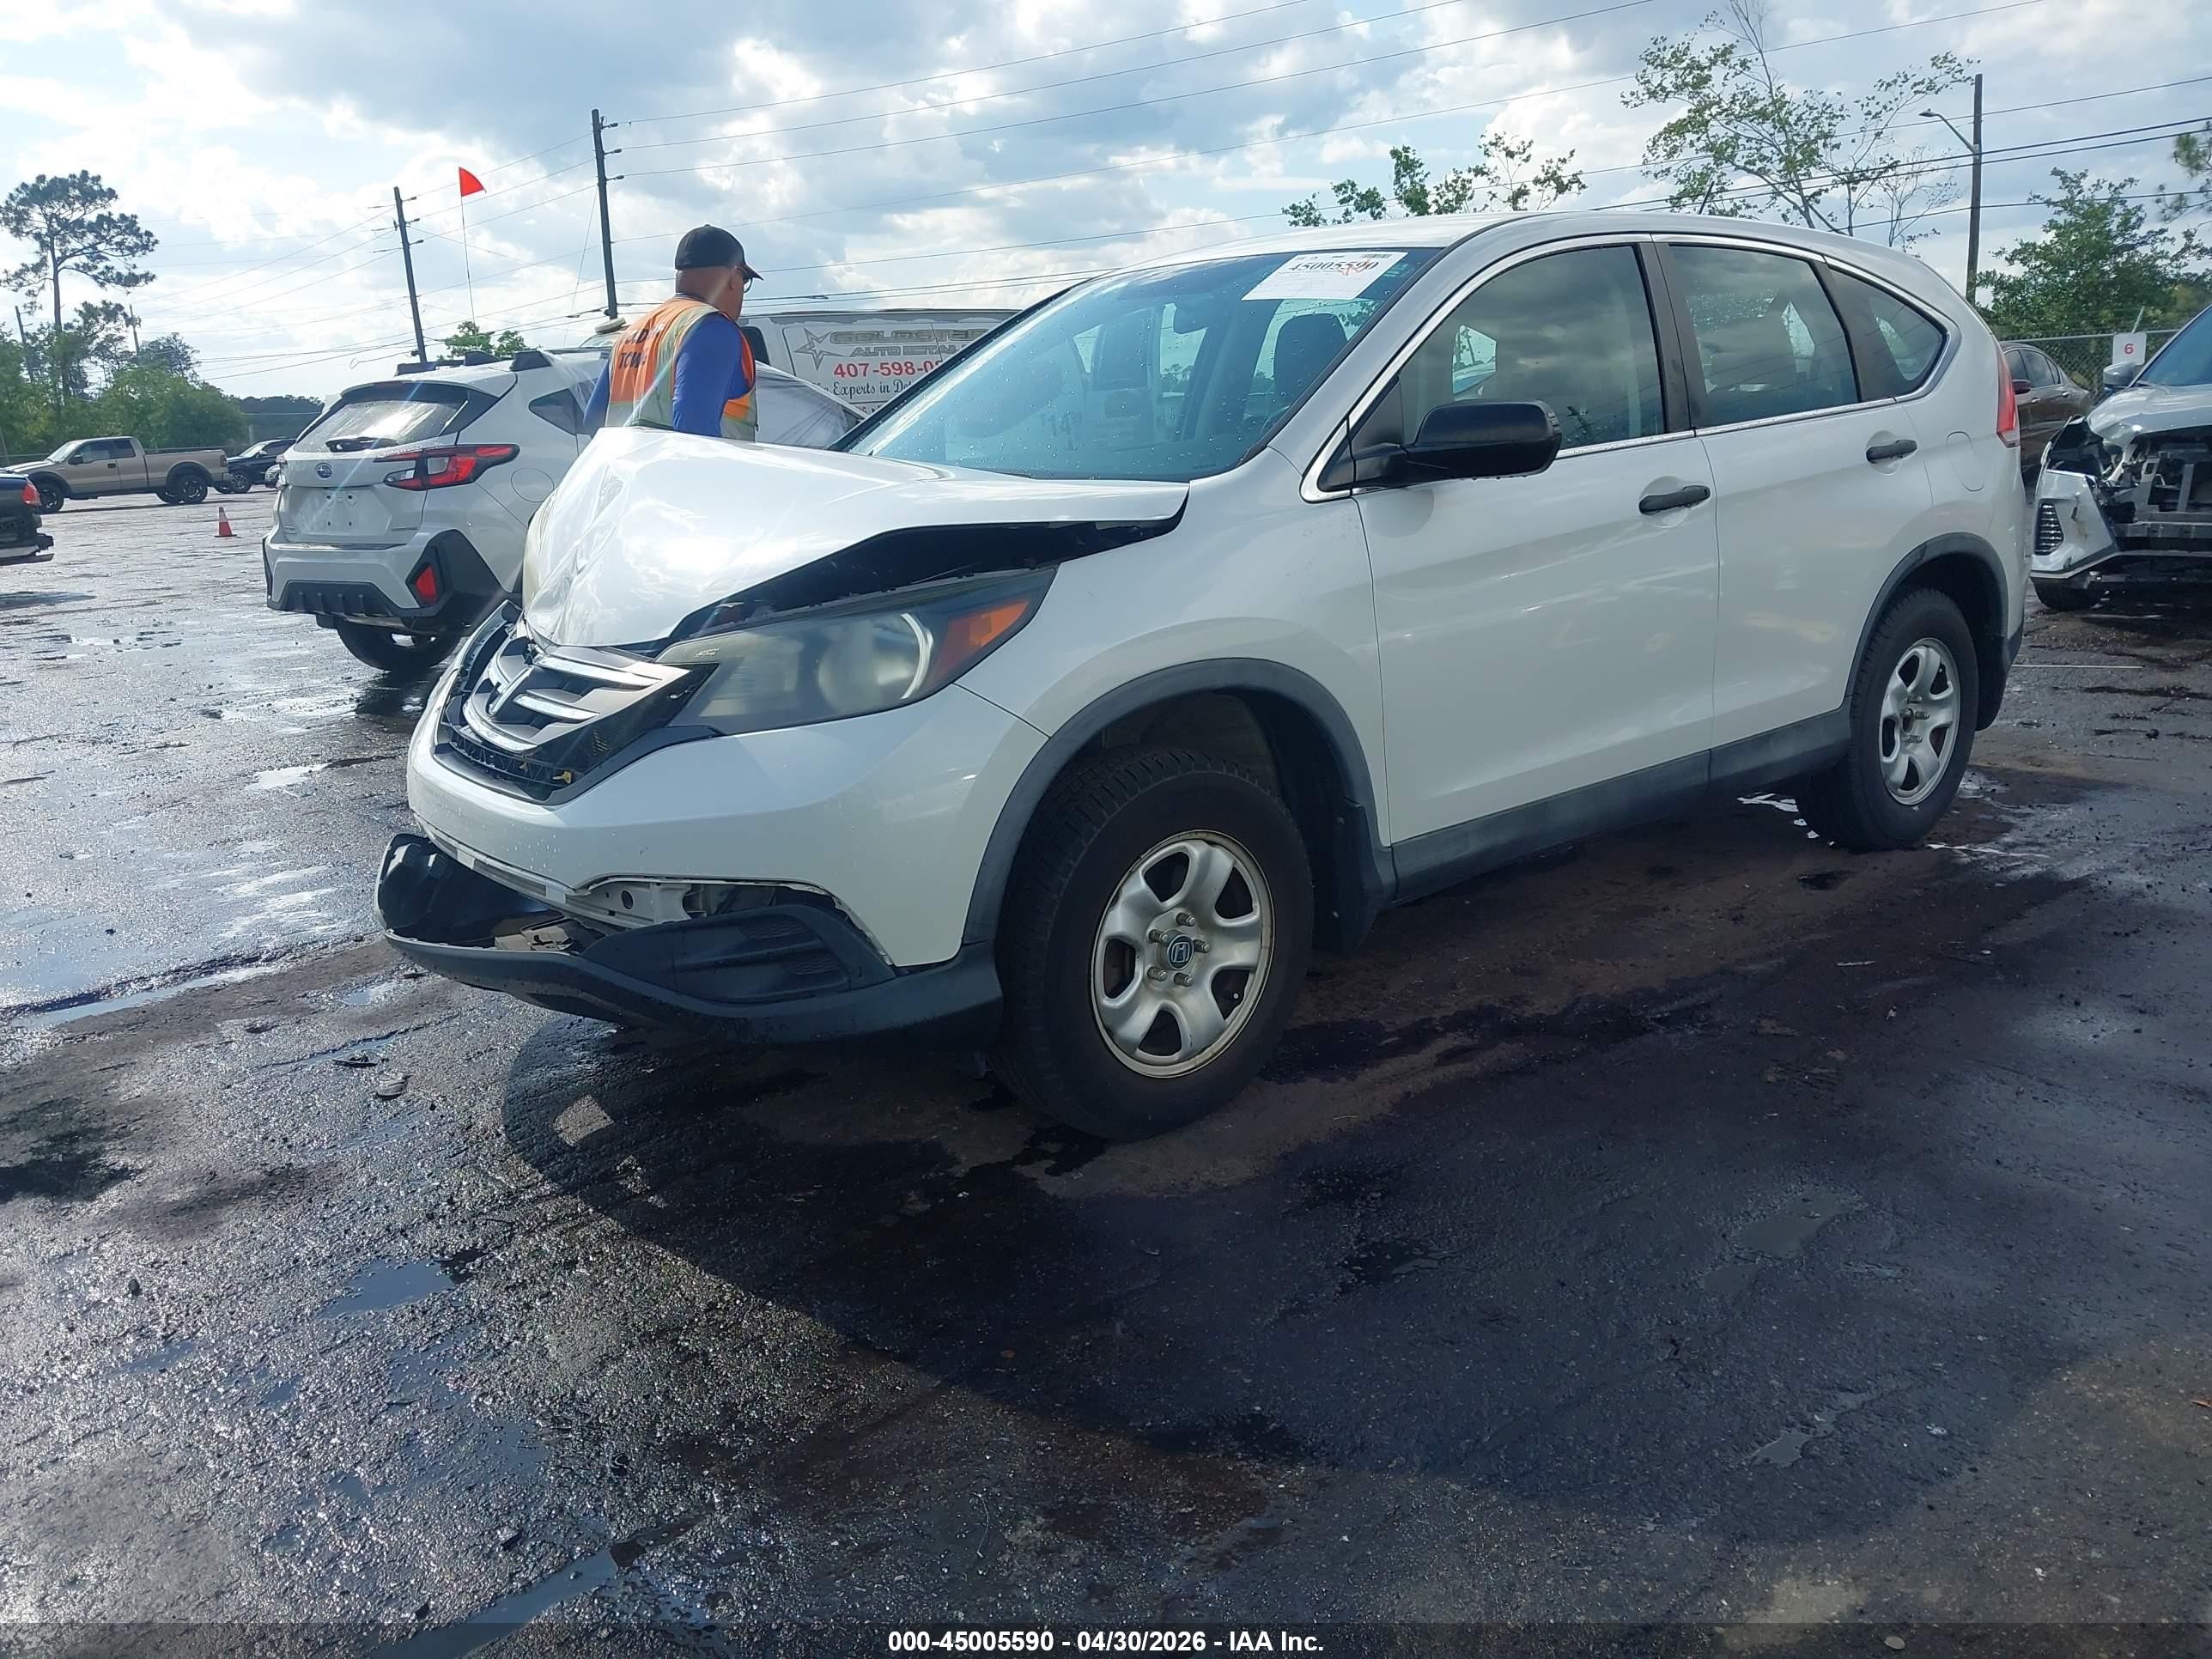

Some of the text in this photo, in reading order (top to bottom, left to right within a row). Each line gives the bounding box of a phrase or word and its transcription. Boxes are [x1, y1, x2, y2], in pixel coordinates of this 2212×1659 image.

[1289, 261, 1379, 271] 45005590
[849, 346, 901, 357] AUTO
[2124, 343, 2134, 355] 6
[833, 381, 876, 399] Experts
[879, 380, 890, 393] in
